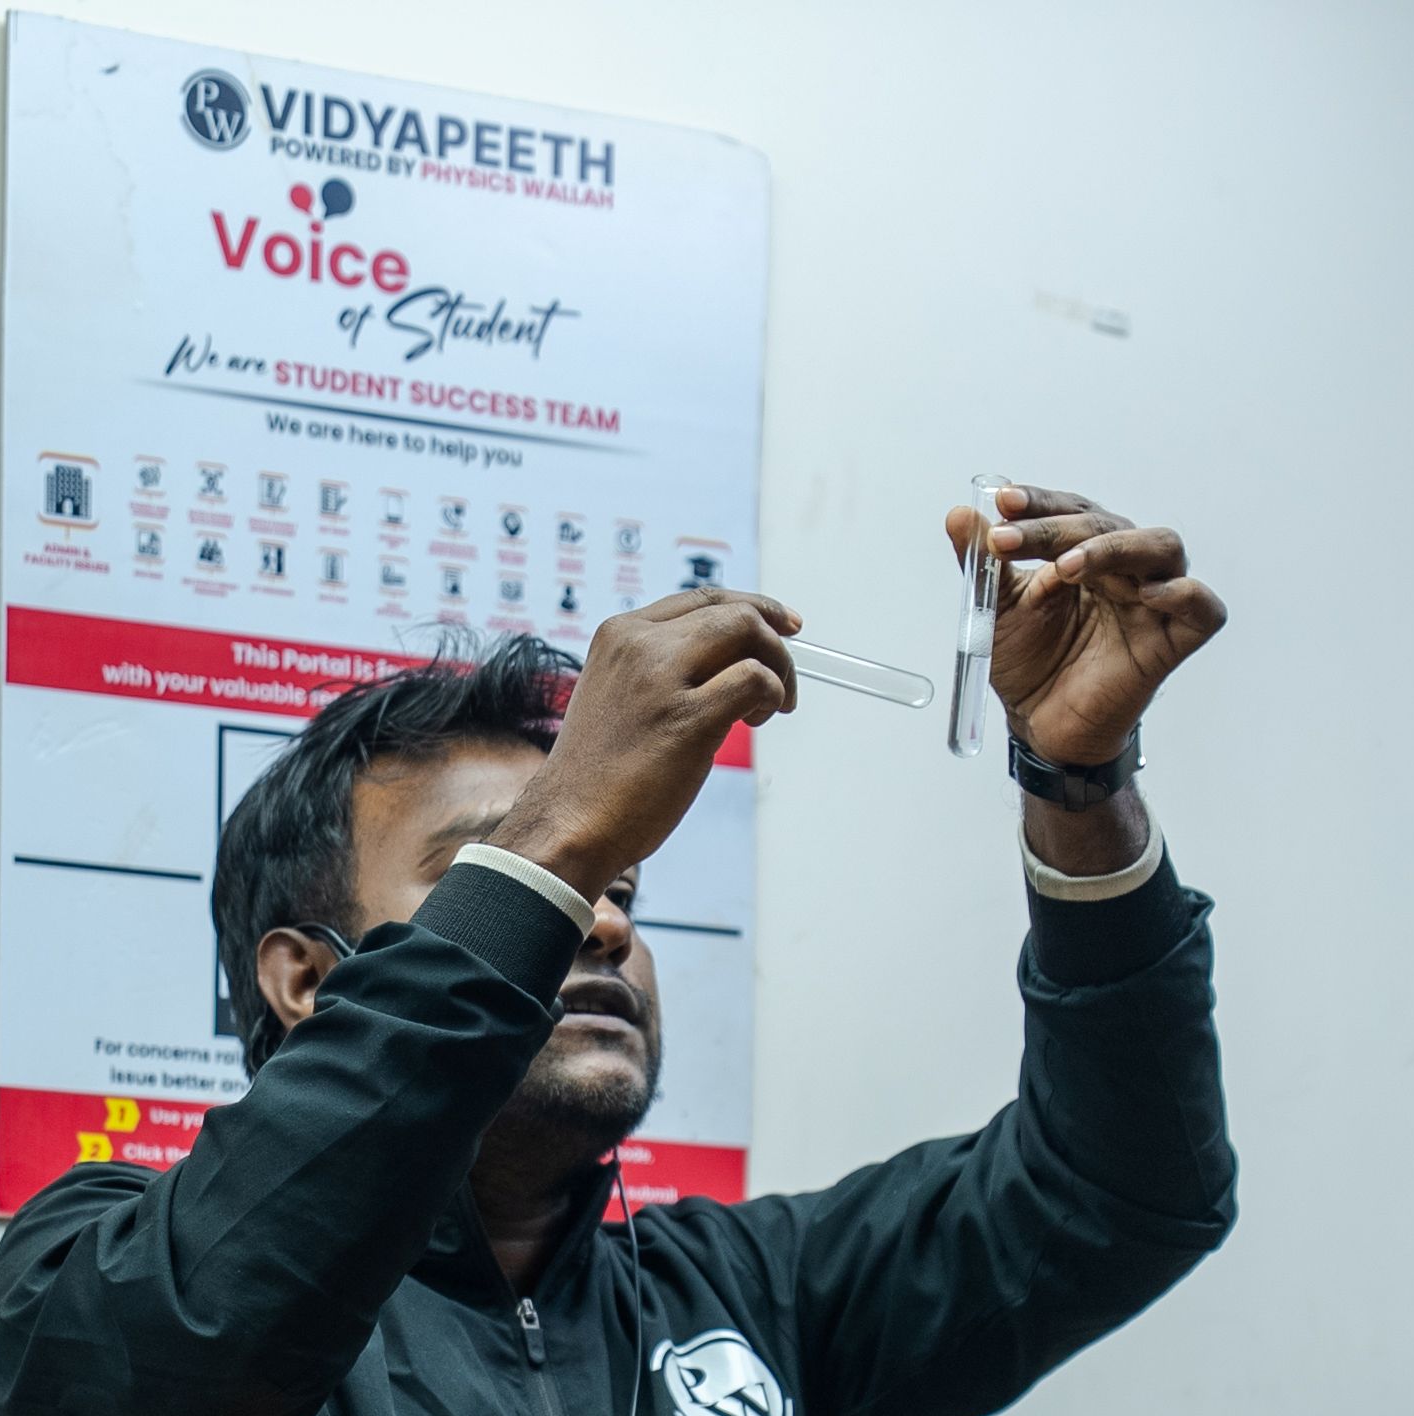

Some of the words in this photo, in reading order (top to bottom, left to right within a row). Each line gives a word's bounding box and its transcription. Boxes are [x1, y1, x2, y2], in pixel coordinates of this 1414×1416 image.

[262, 83, 615, 187] VIDYAPEETH
[270, 137, 382, 174] POWERED
[387, 154, 417, 176] BY
[420, 160, 517, 197] PHYSICS
[523, 174, 615, 209] WALLAH
[210, 208, 411, 294] Voice
[338, 299, 377, 349] of
[387, 287, 581, 361] Student
[164, 334, 221, 377] We
[227, 353, 267, 378] are
[274, 360, 402, 403] STUDENT
[410, 379, 538, 423] SUCCESS
[545, 399, 622, 434] TEAM
[266, 411, 300, 436] We
[307, 422, 345, 443] are
[349, 421, 398, 449] here
[403, 433, 426, 455] to
[429, 436, 478, 469] help
[482, 447, 523, 468] you
[102, 661, 152, 687] with
[155, 671, 206, 695] your
[210, 676, 306, 707] valuable
[232, 642, 279, 668] This
[282, 648, 352, 680] Portal
[353, 655, 374, 681] is
[94, 1037, 123, 1055] For
[126, 1044, 211, 1064] concerns
[161, 1070, 216, 1091] better
[149, 1107, 179, 1126] Use
[122, 1141, 164, 1162] Click
